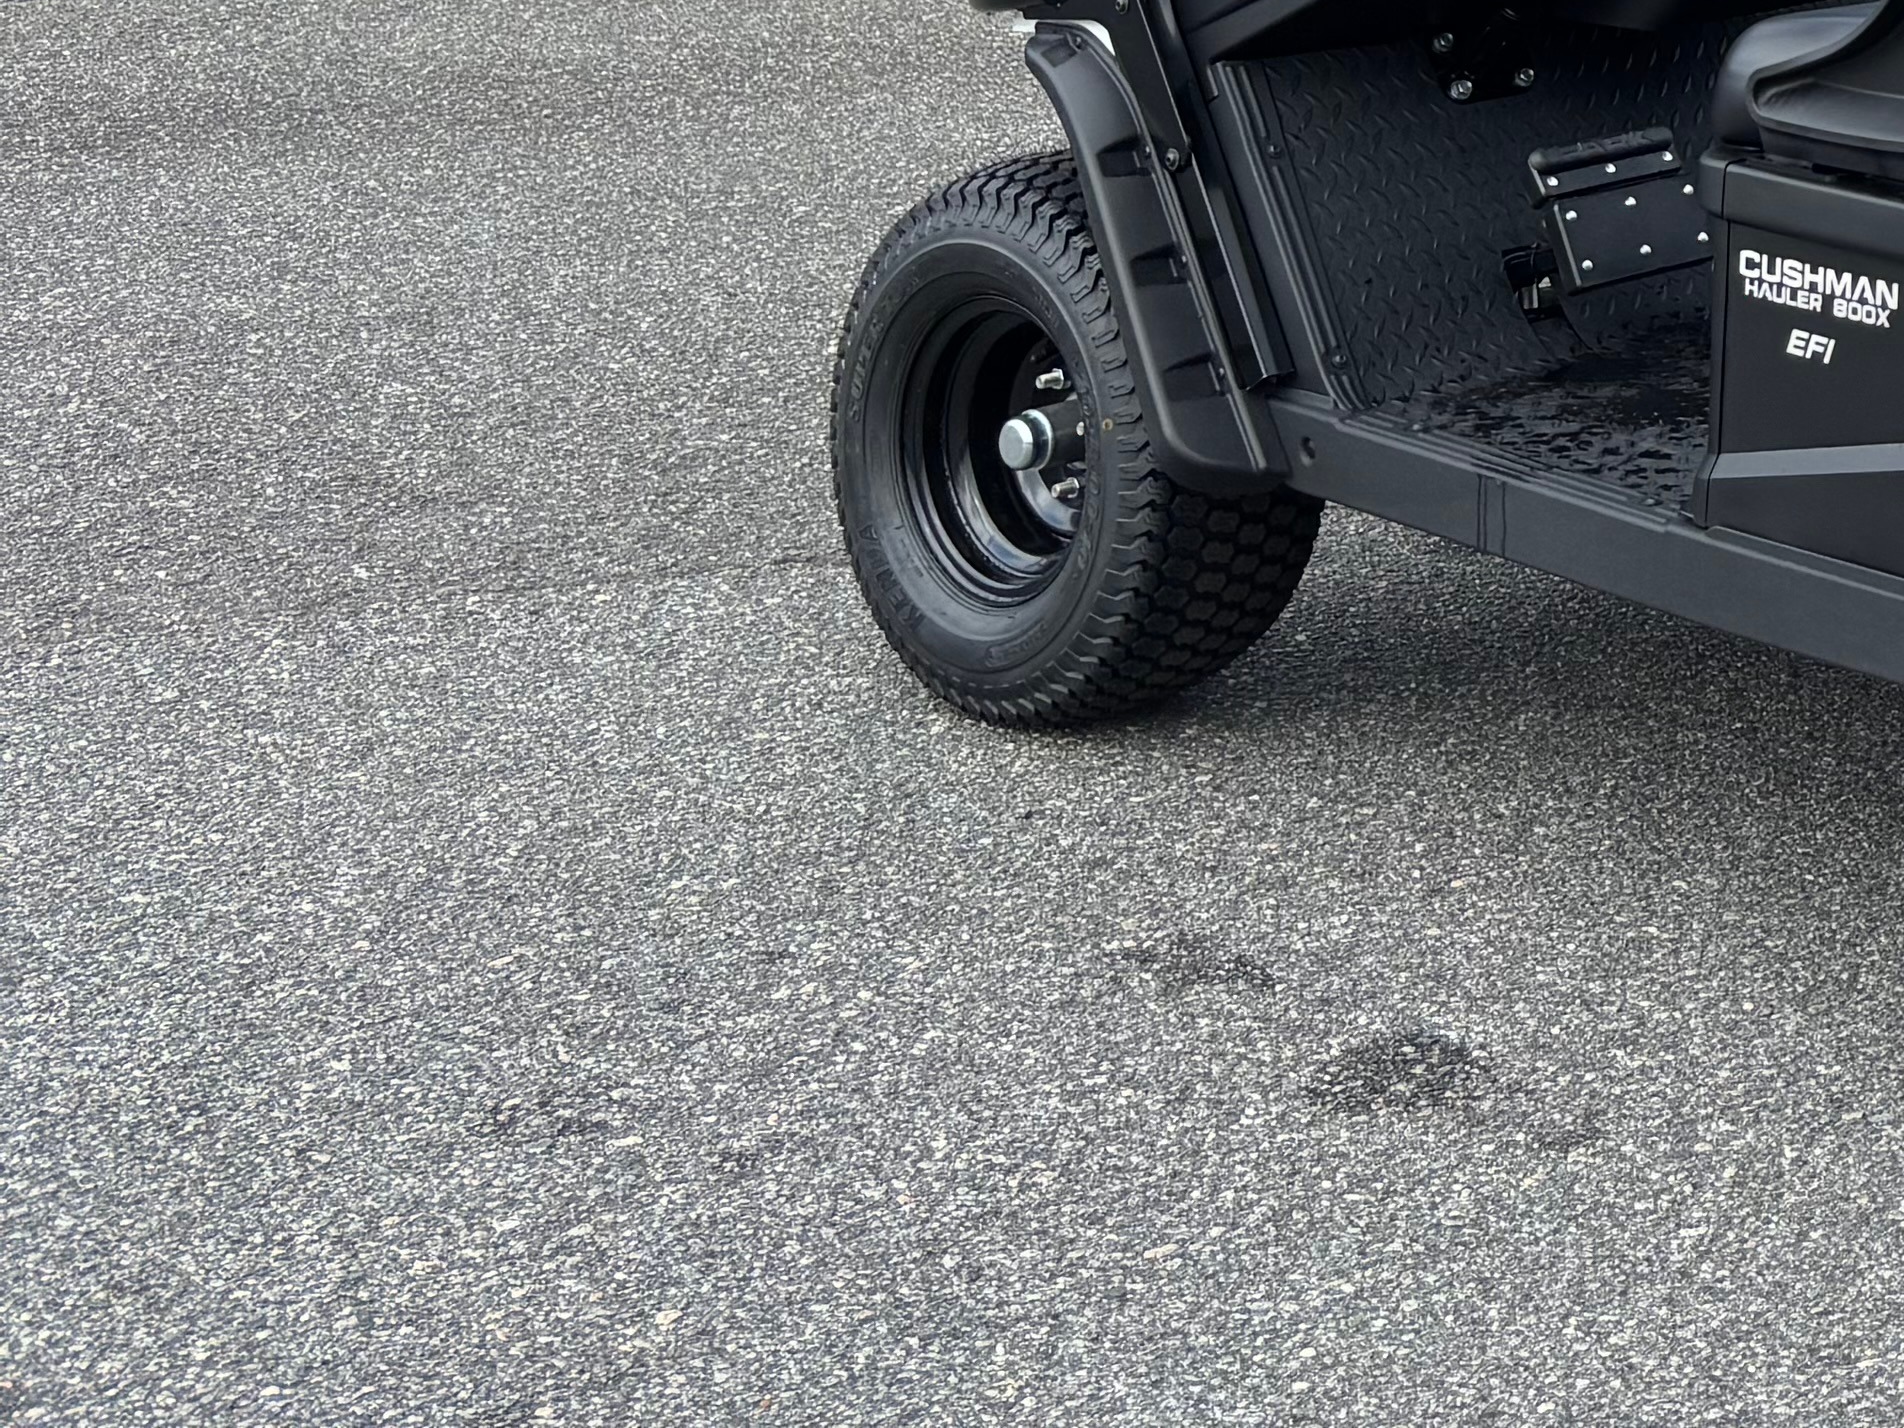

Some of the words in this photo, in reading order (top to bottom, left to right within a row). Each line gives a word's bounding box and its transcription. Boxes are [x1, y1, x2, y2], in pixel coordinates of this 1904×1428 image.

[1739, 249, 1899, 310] CUSHMAN
[1744, 278, 1823, 312] HAULER
[1833, 298, 1890, 328] 800X
[1786, 328, 1836, 364] EFI
